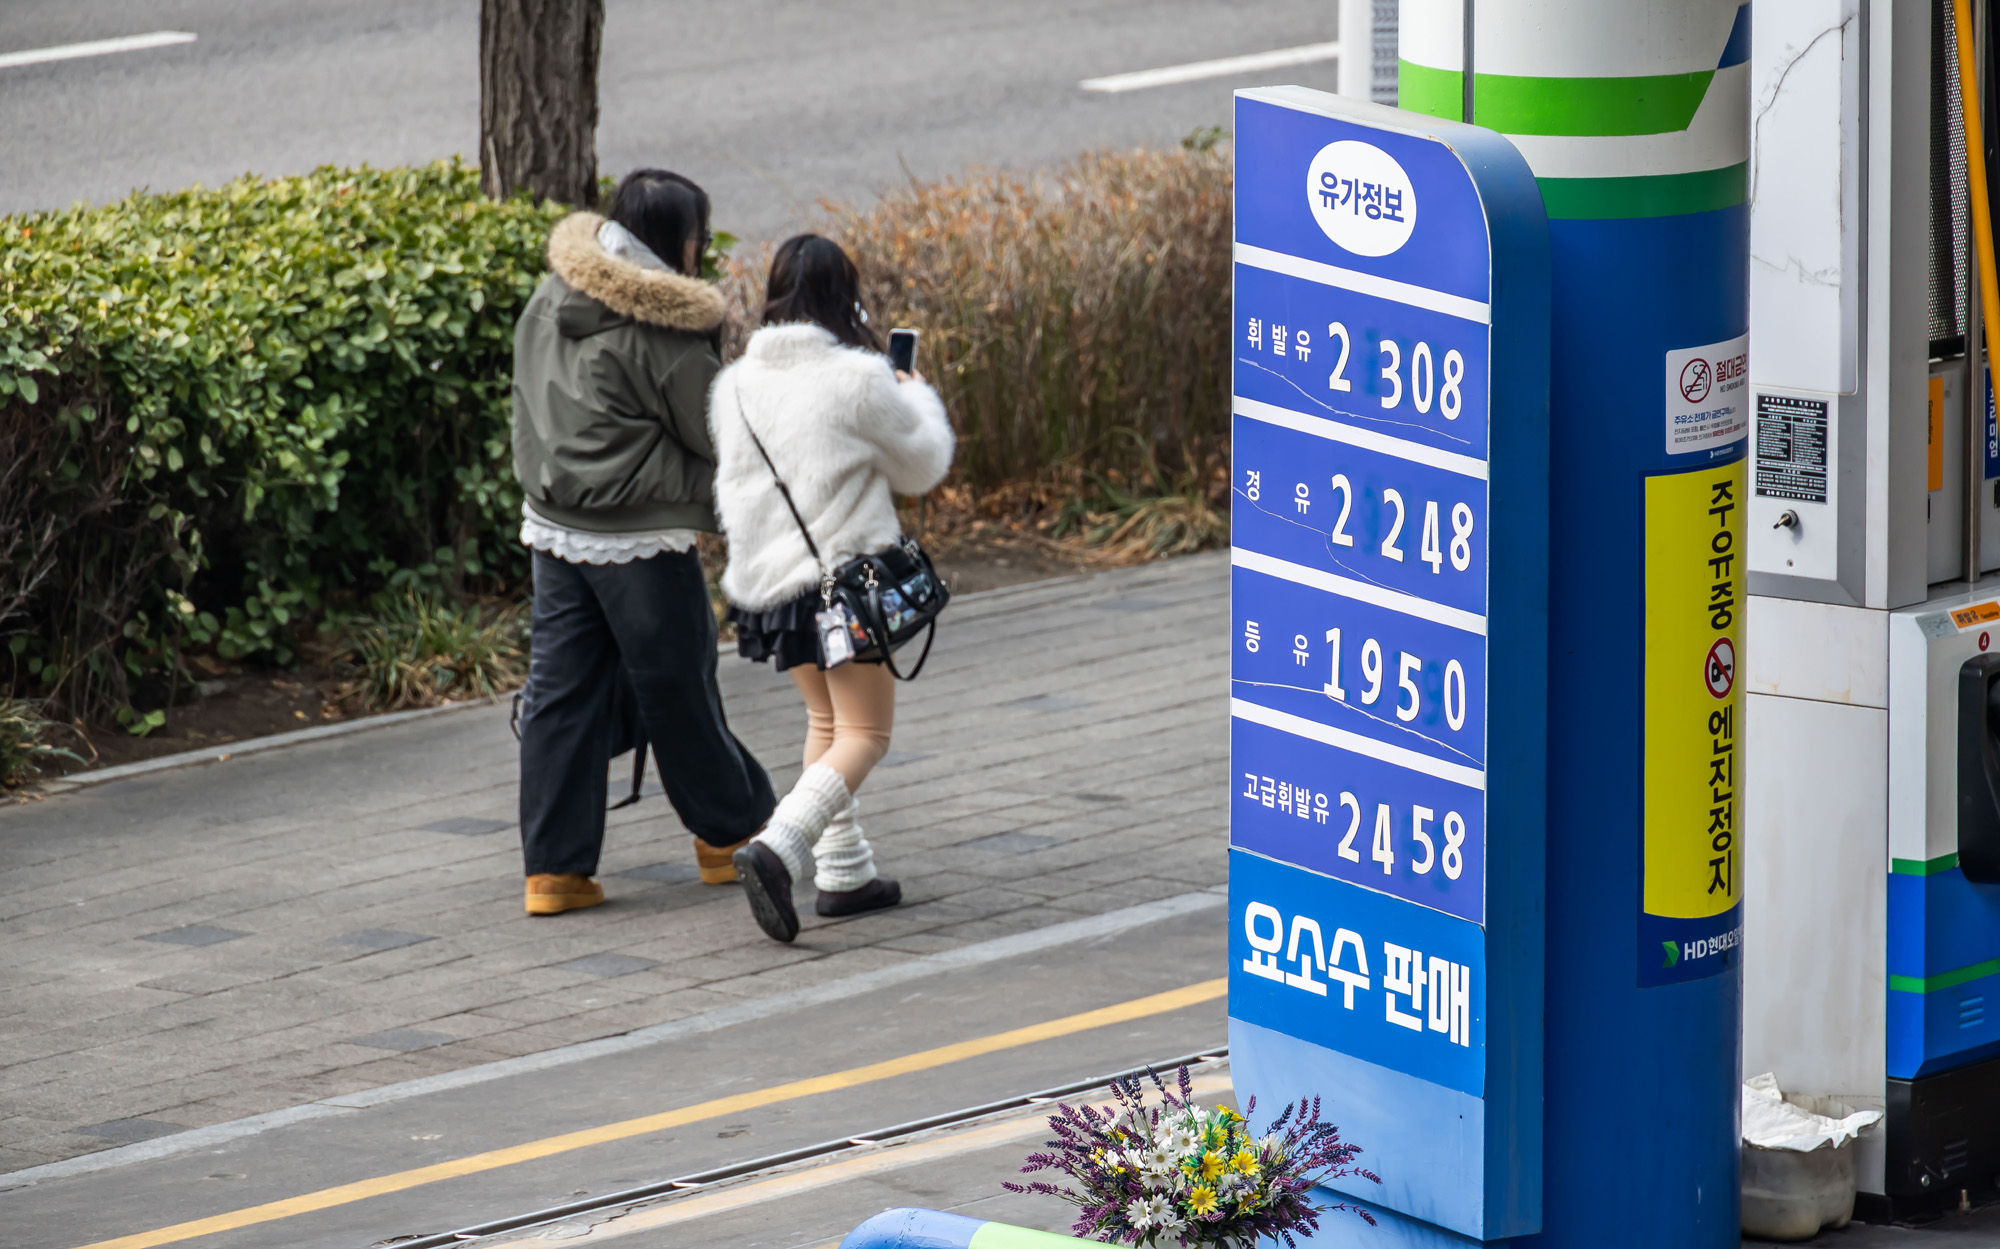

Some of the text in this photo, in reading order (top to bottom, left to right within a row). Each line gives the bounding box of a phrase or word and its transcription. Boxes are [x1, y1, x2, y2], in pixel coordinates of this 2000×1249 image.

[1318, 172, 1405, 223] 유가정보
[1674, 414, 1694, 425] 주유소
[1708, 480, 1735, 630] 주유중
[1323, 627, 1466, 732] 1950
[1982, 635, 1987, 647] 4
[1243, 772, 1467, 881] 고급휘발유 2458
[1707, 704, 1733, 897] 엔진정지
[1243, 901, 1470, 1048] 요소수 판매
